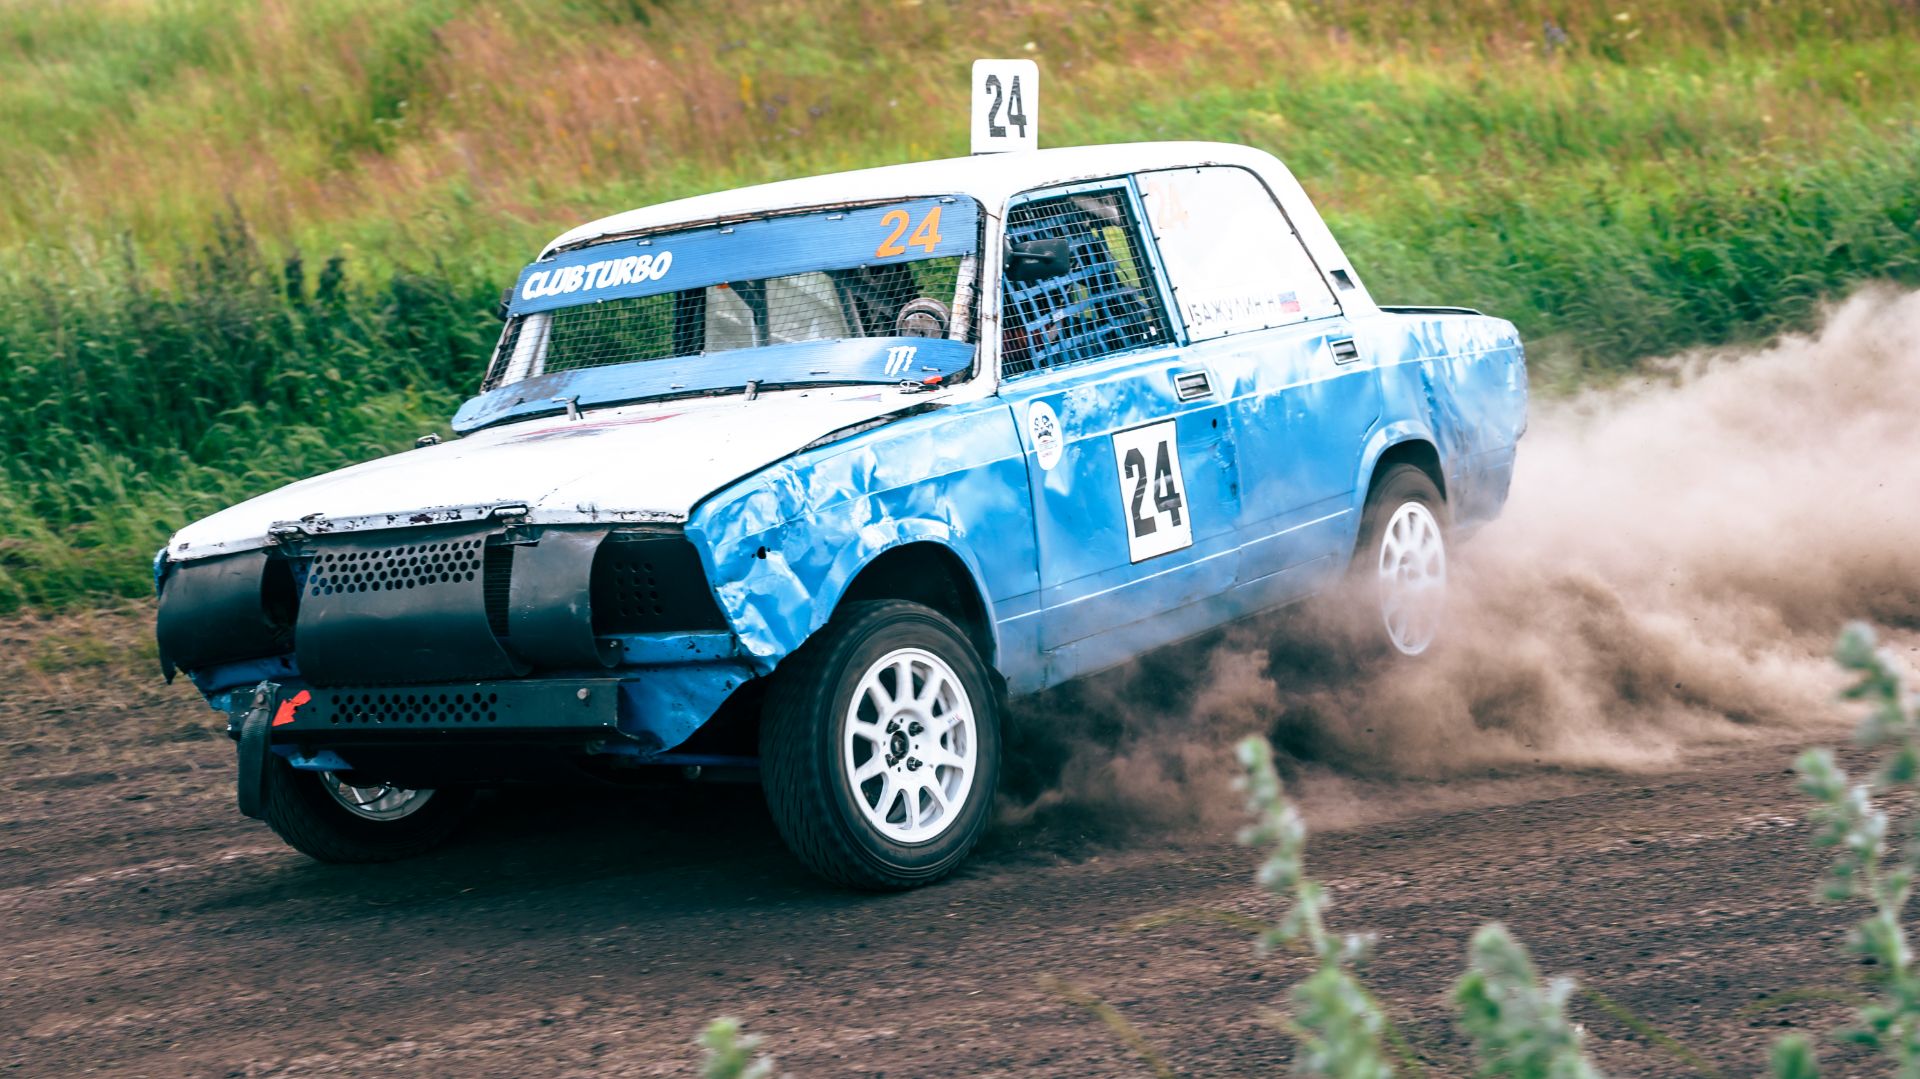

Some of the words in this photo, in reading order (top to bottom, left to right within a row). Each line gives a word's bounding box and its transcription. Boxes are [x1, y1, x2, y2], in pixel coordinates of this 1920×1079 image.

[985, 74, 1027, 138] 24
[876, 206, 942, 257] 24
[1147, 184, 1189, 229] 24
[521, 250, 673, 300] CLUBTURBO
[1124, 441, 1182, 538] 24
